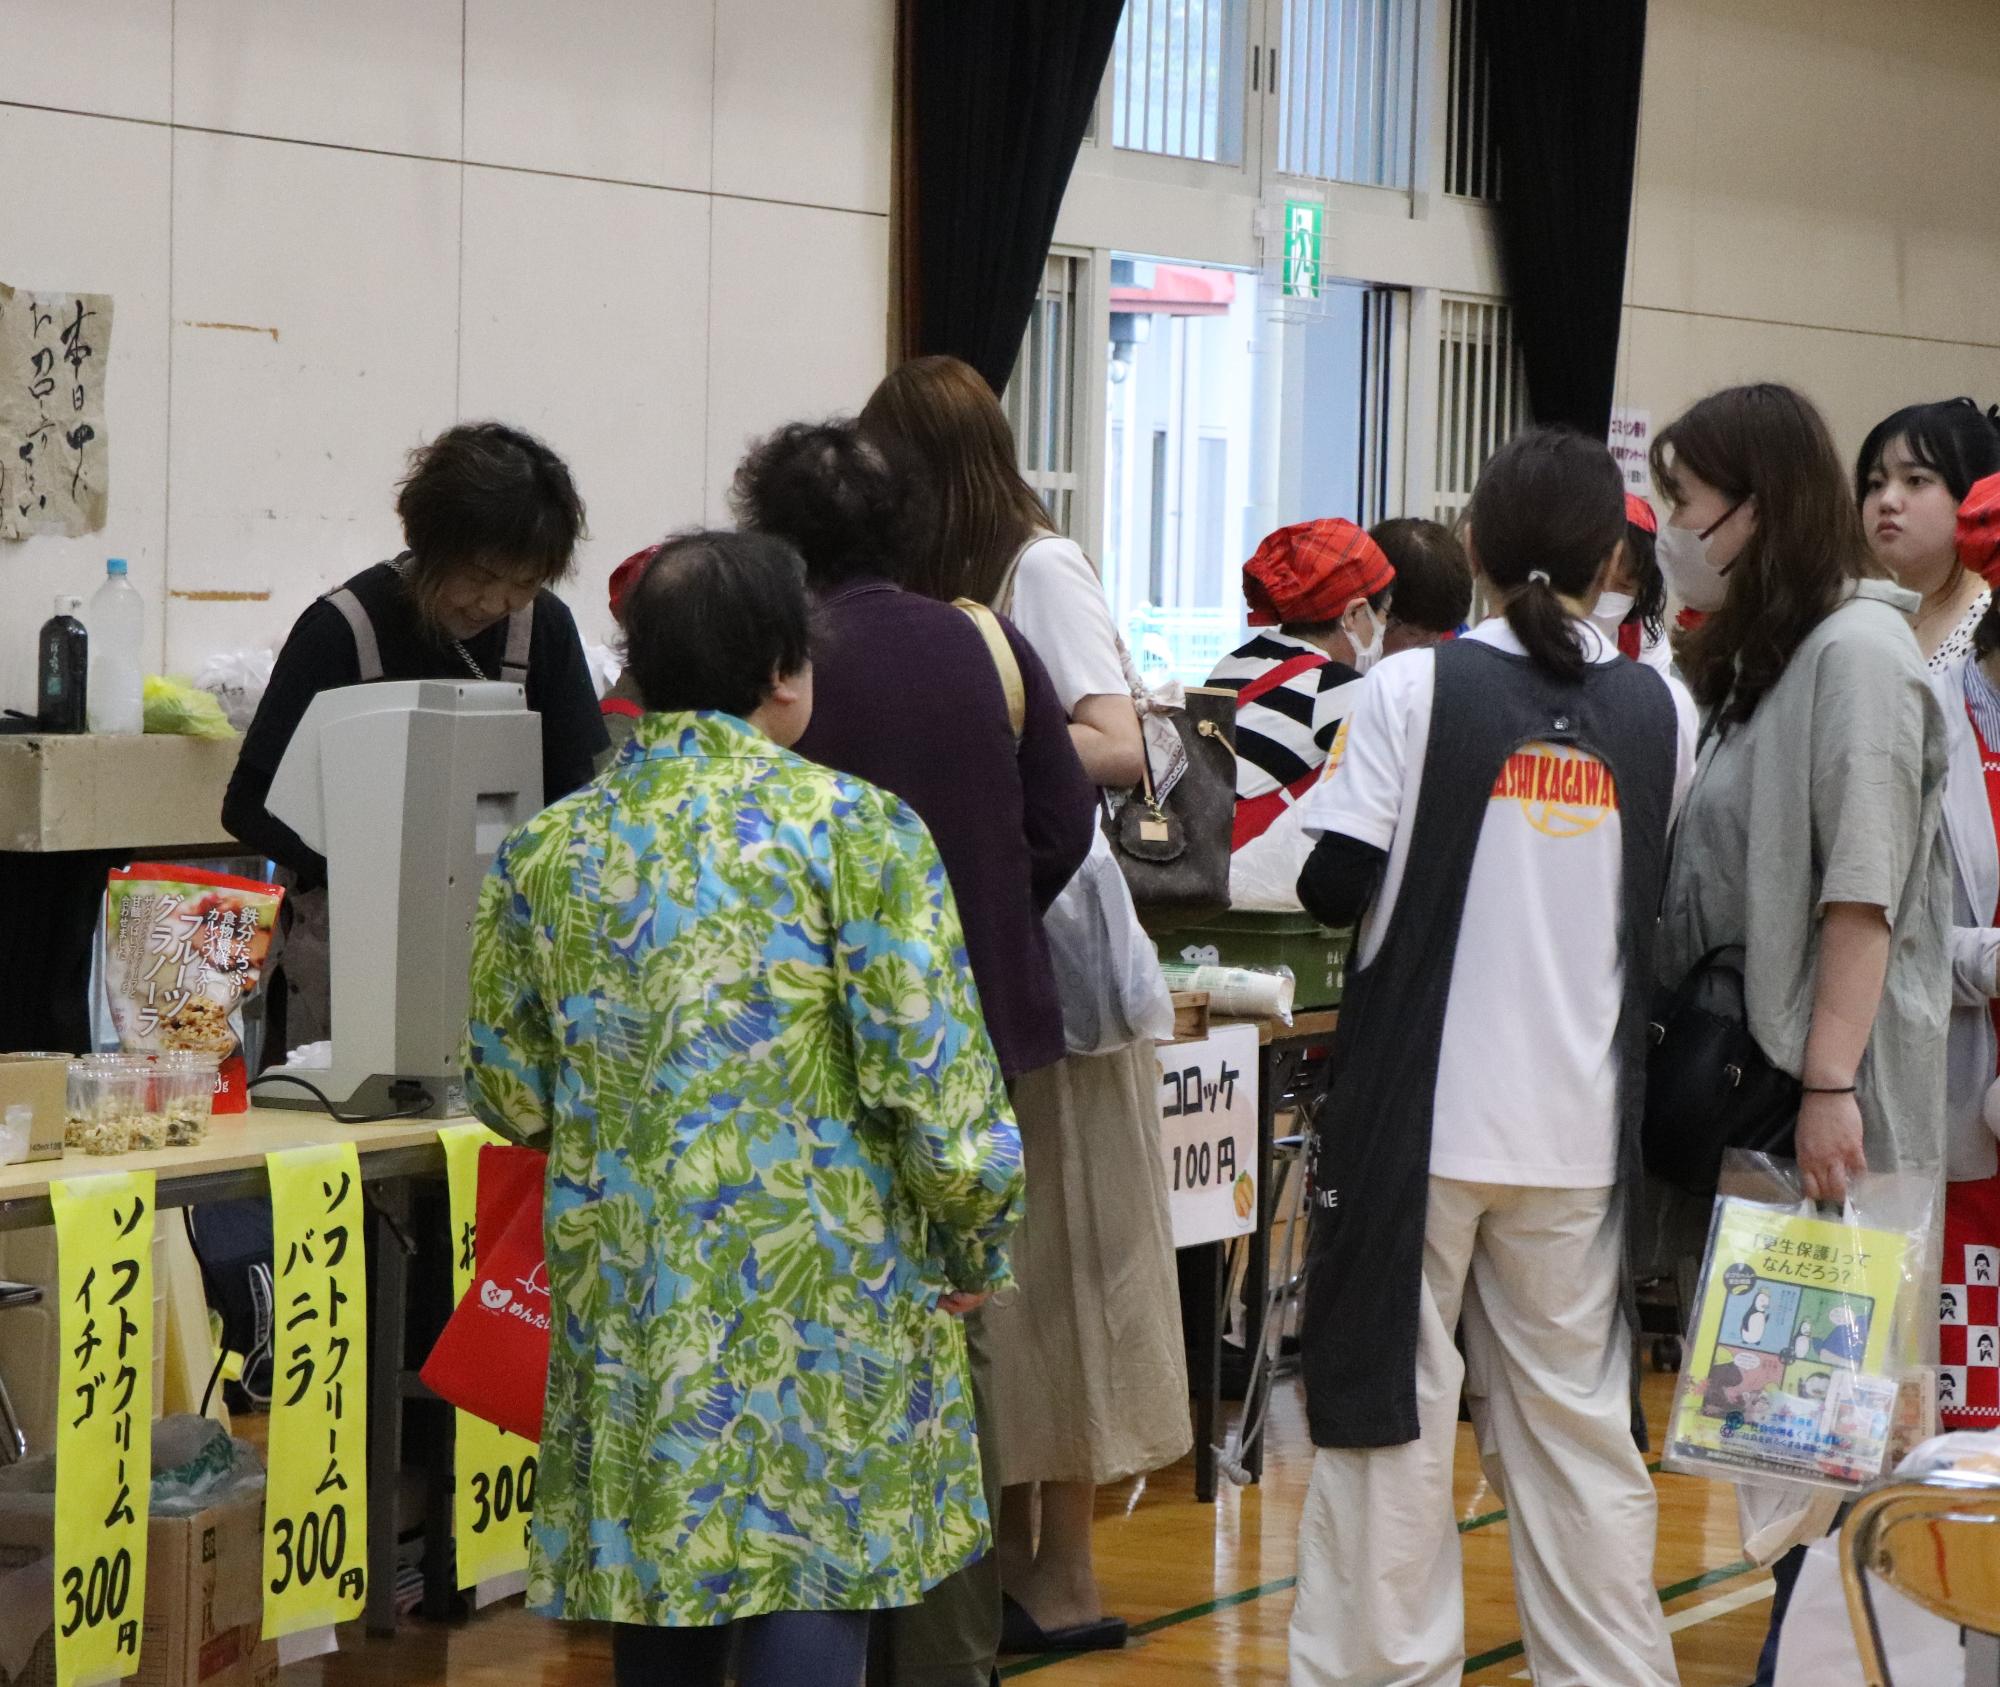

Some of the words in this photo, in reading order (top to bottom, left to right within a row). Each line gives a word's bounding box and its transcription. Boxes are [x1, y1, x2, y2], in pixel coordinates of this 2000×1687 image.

[138, 893, 184, 1038] グラノーラ
[165, 913, 204, 1019] フルーツ
[229, 906, 259, 1001] 鉄分たっぷり
[1162, 1060, 1239, 1119] コロッケ
[1173, 1136, 1236, 1191] 100円
[282, 1228, 319, 1407] バニラ
[315, 1171, 350, 1495] ソフトクリーム
[1763, 1256, 1852, 1285] なんだろう?
[73, 1266, 107, 1430] イチゴ
[104, 1196, 145, 1528] ソフトクリーム
